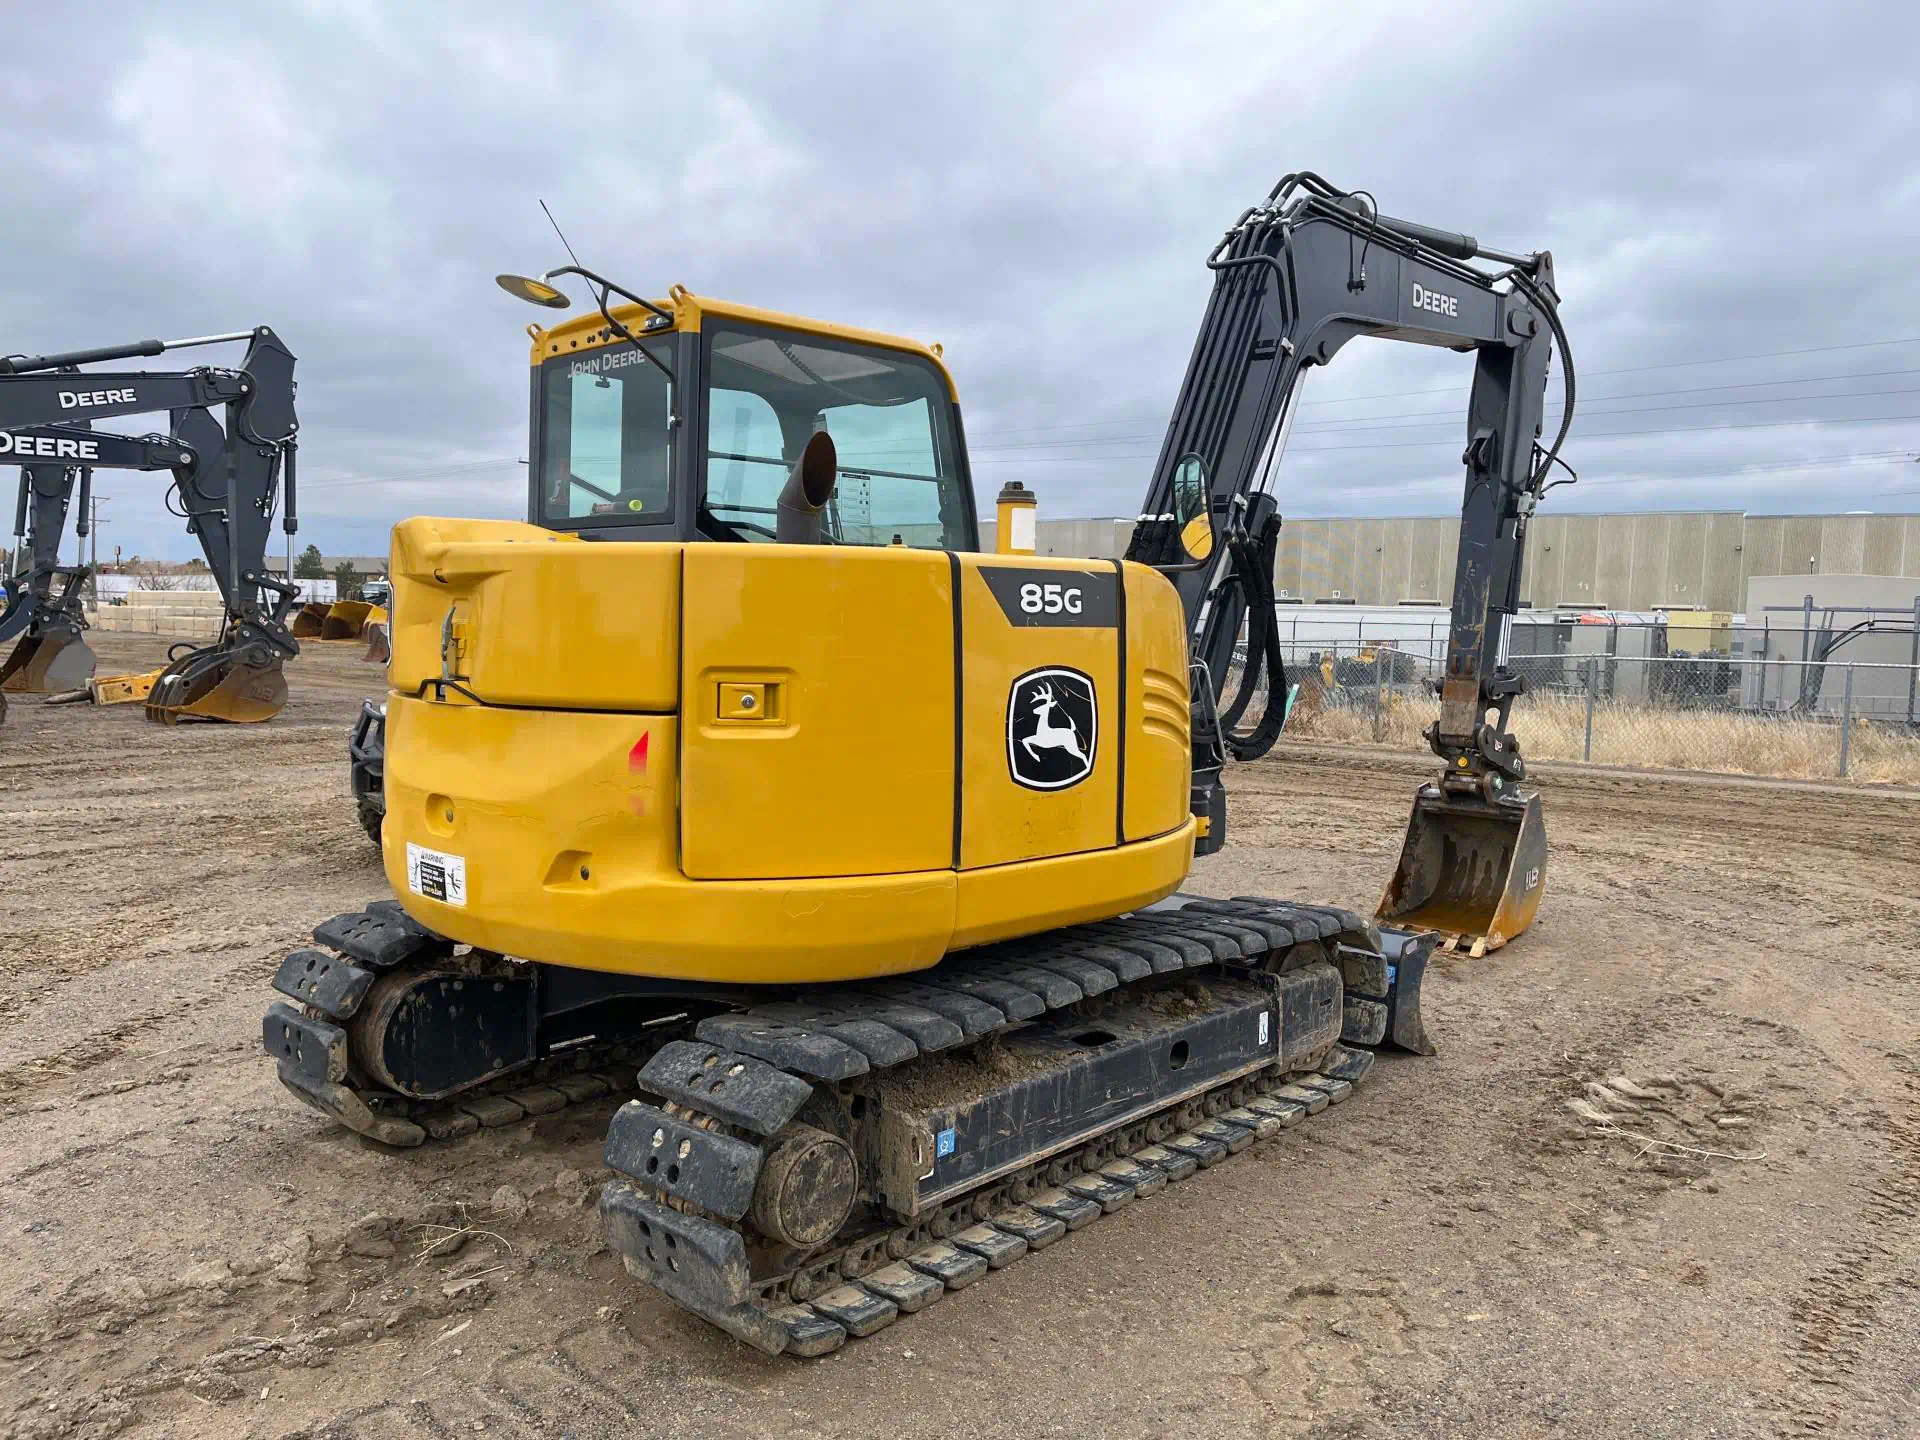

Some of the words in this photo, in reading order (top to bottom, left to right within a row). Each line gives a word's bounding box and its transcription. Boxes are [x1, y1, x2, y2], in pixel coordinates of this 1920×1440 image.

[1412, 282, 1458, 317] DEERE
[567, 358, 600, 378] JOHN
[602, 349, 645, 371] DEERE
[58, 388, 137, 409] DEERE
[1020, 583, 1082, 613] 85G
